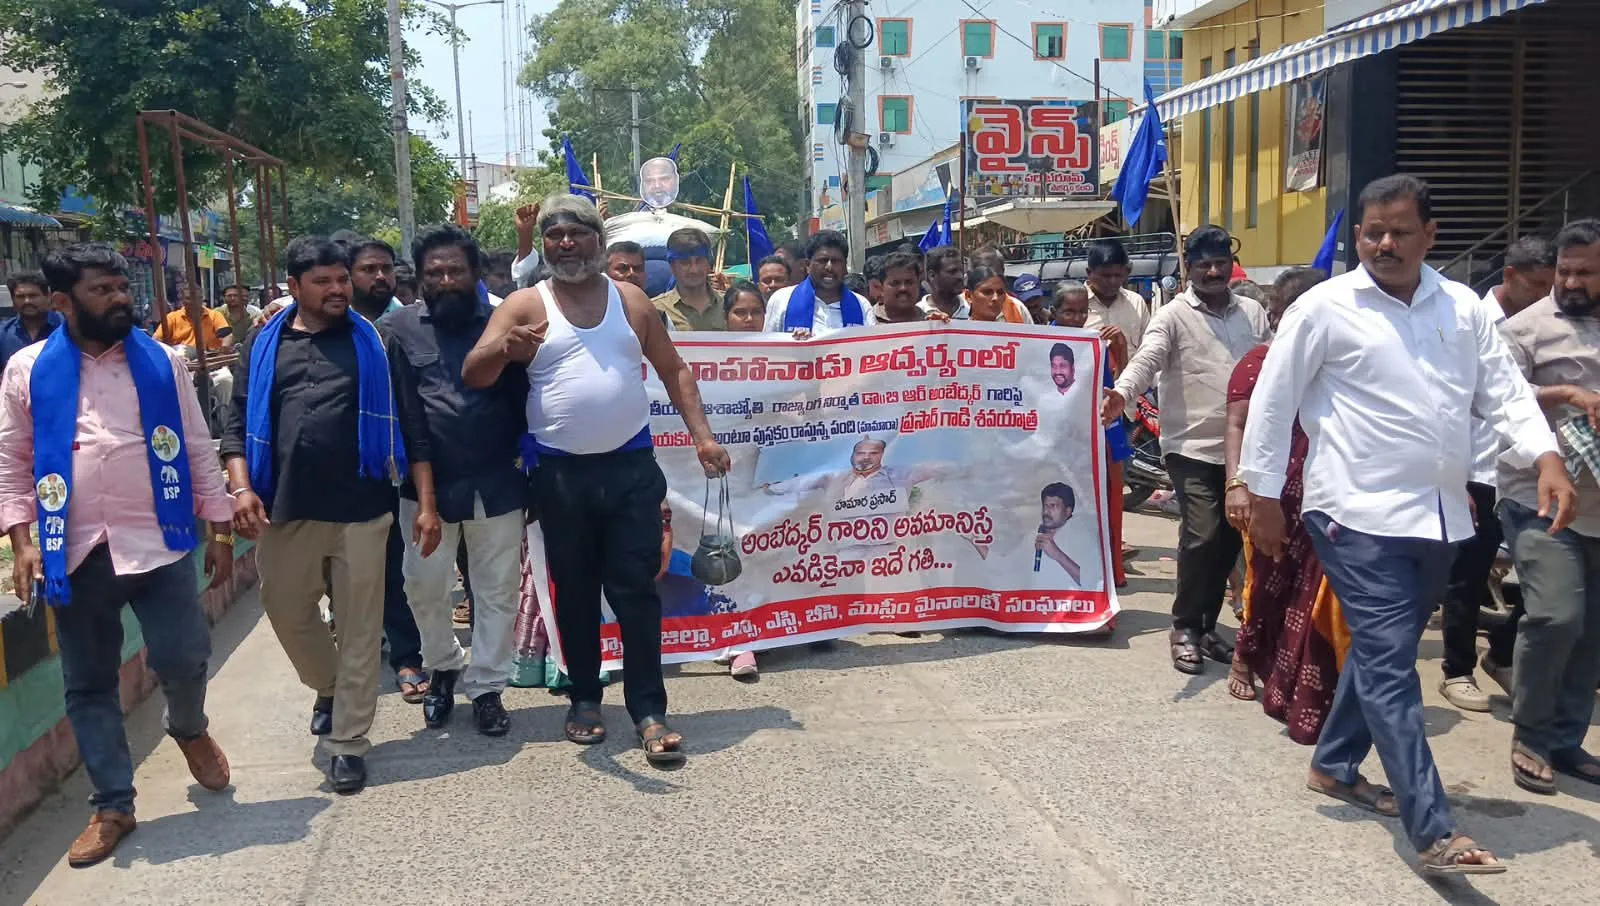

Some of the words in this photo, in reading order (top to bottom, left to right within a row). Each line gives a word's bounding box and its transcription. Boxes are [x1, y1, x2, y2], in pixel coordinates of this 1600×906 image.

[974, 105, 1092, 172] వైన్స్
[903, 385, 926, 401] ఆర్
[900, 408, 938, 433] ప్రసాద్
[940, 407, 970, 427] గాడి
[974, 408, 1038, 430] శవయాత్ర
[163, 486, 180, 501] BSP
[741, 513, 823, 554] అంబేద్కర్
[828, 516, 889, 542] గారిని
[894, 506, 993, 545] అవమానిస్తే
[46, 536, 64, 551] BSP
[772, 553, 865, 588] ఎవడికైనా
[871, 545, 905, 577] ఇదే
[1005, 596, 1095, 614] సంఘాలు
